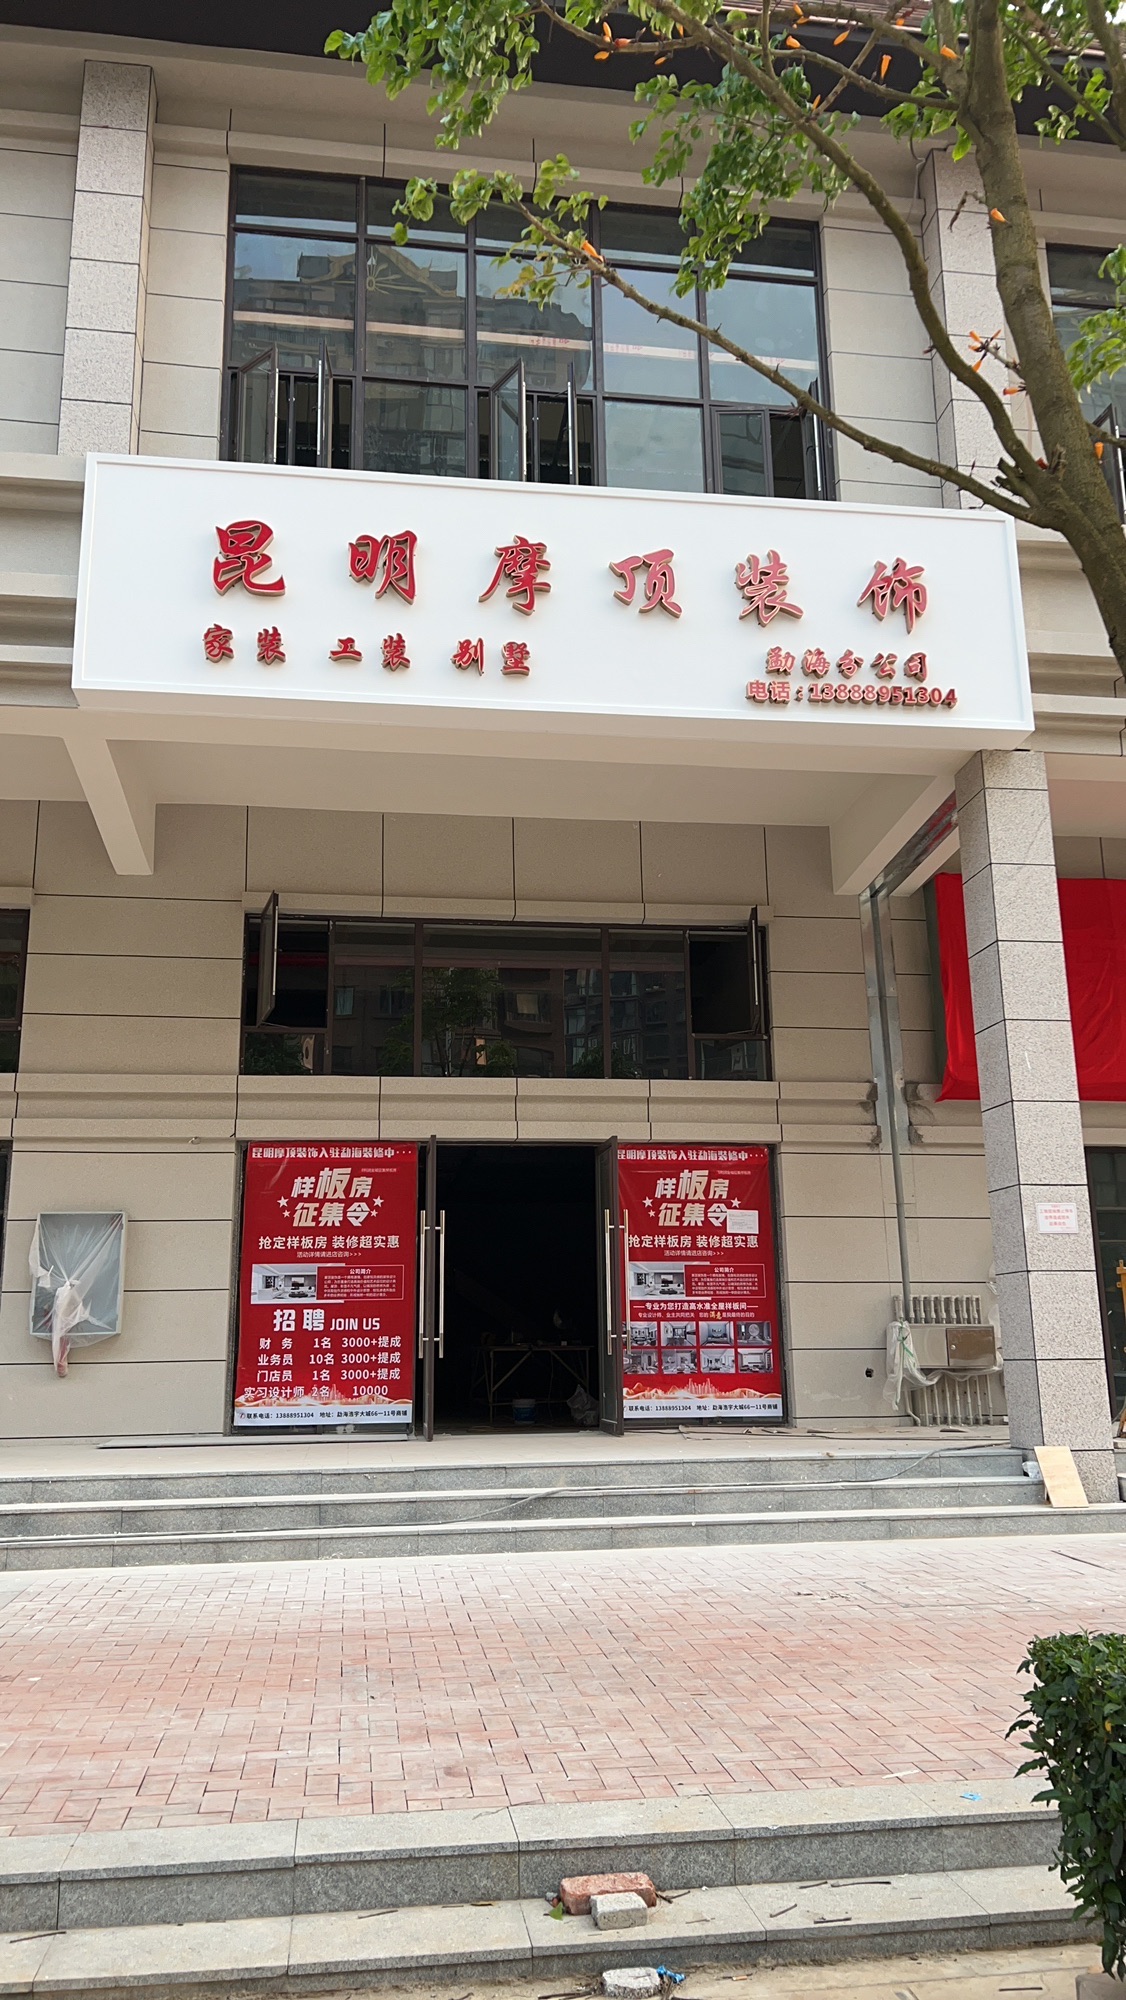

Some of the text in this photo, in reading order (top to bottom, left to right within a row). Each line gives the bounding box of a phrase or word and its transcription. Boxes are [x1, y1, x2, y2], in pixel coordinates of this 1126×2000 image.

[212, 519, 929, 635] 昆明摩顶装饰
[203, 623, 530, 677] 家装 工装 别墅
[764, 646, 929, 682] 勐海分公司
[291, 1167, 373, 1199] 样板房
[655, 1169, 730, 1200] 样板房
[293, 1202, 371, 1227] 征集令
[658, 1203, 728, 1227] 征集令
[258, 1235, 400, 1250] 抢定样板房 装修超实惠
[628, 1235, 759, 1248] 抢定样板房 装修超实惠
[273, 1309, 325, 1332] 招聘
[330, 1318, 381, 1331] JOIN US
[259, 1336, 402, 1350] 财务 1名 3000+提成
[257, 1352, 401, 1366] 业务员 10名 3000+提成
[256, 1368, 401, 1382] 门店员 1名 3000+提成
[244, 1386, 388, 1399] 实习设计师 2名 10000
